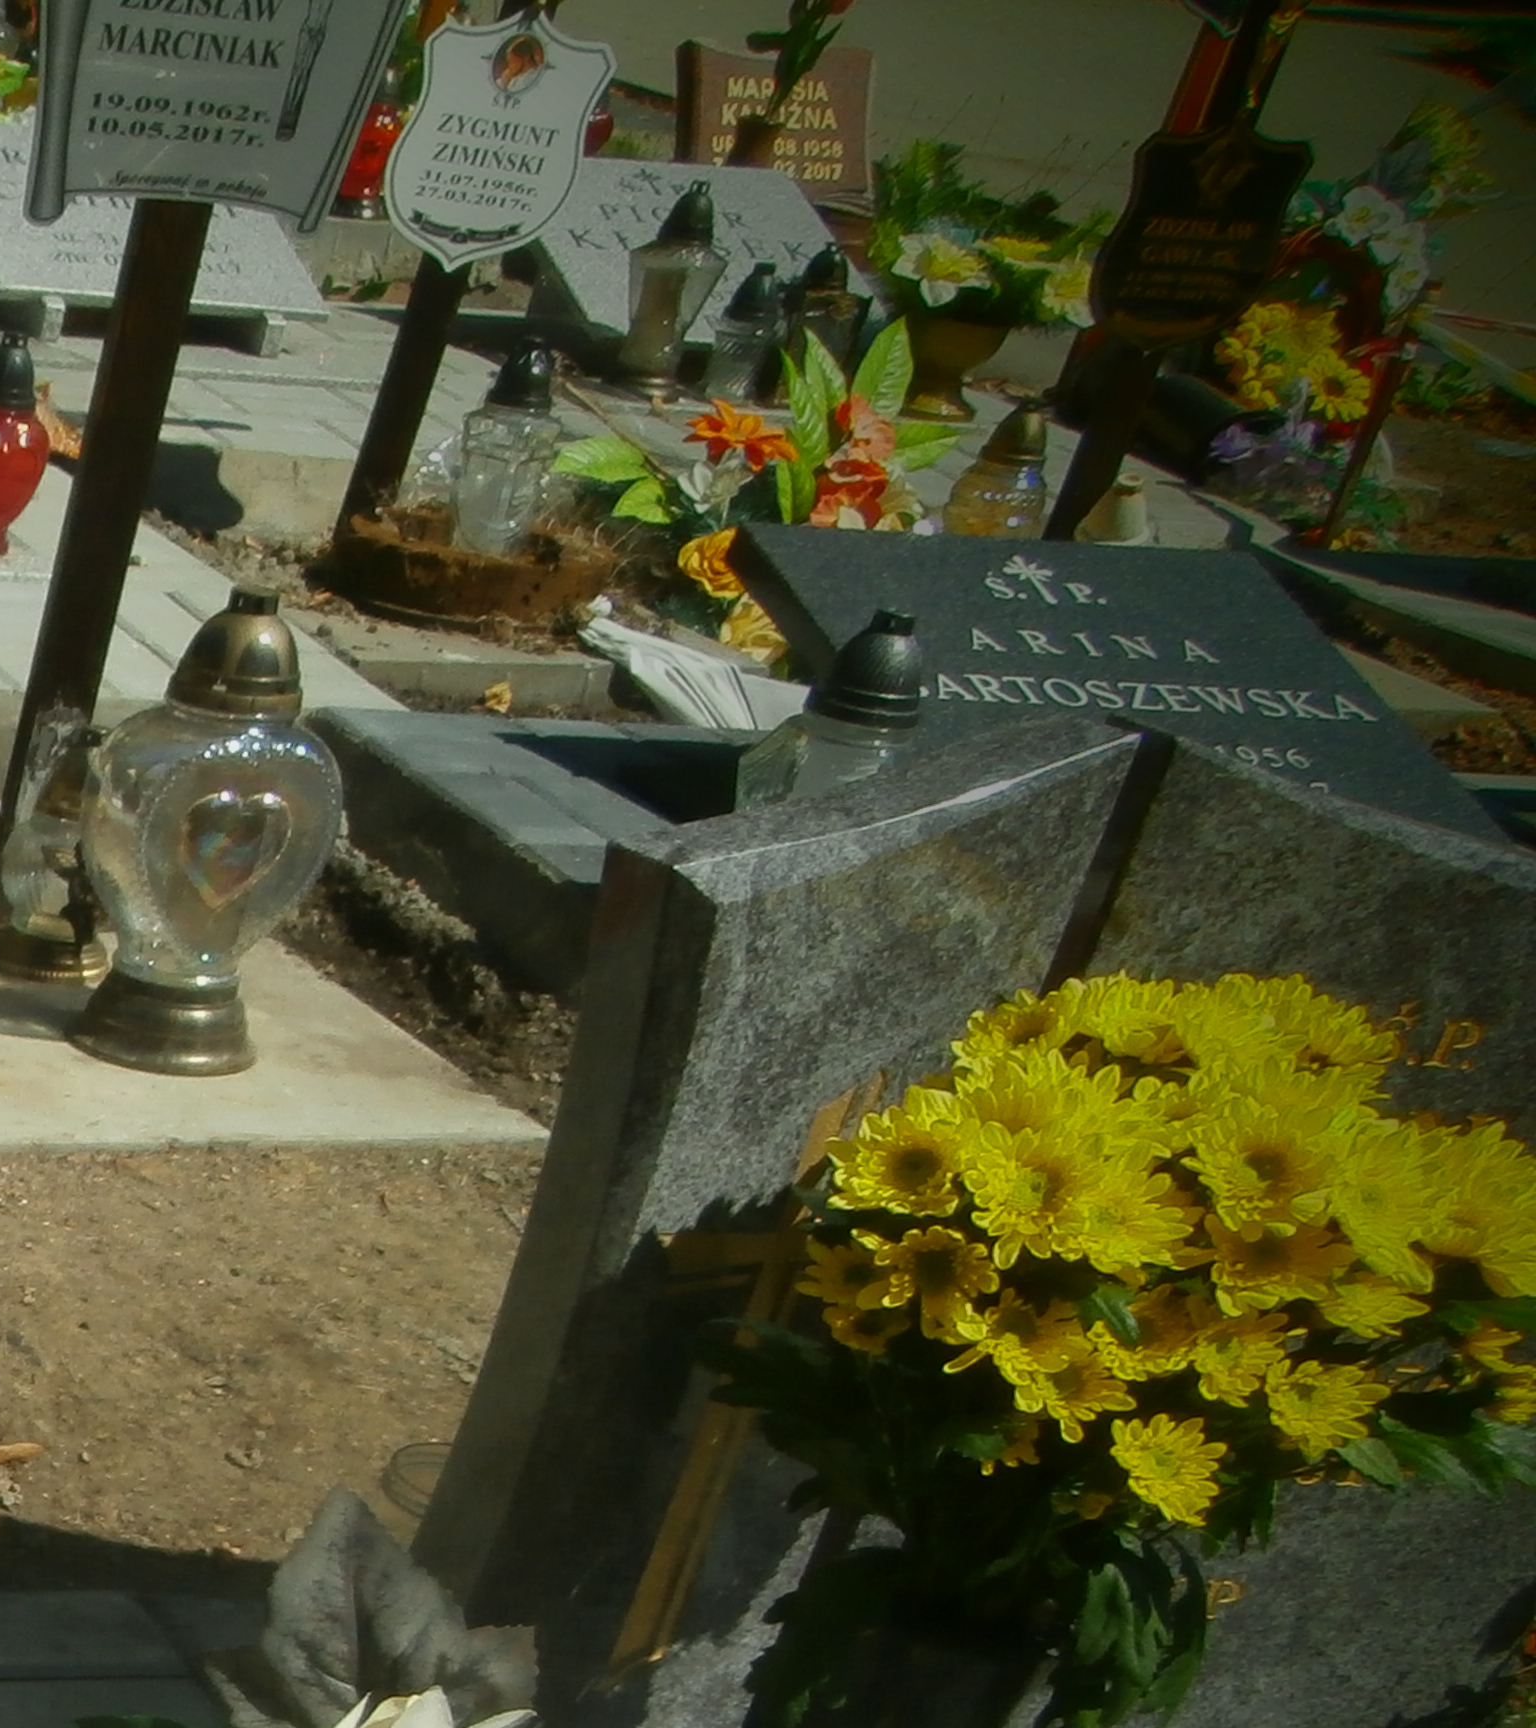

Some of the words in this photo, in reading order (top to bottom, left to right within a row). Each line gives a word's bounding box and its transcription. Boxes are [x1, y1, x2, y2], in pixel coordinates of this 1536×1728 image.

[98, 21, 286, 69] MARCINIAK
[727, 76, 830, 102] MARSIA
[93, 91, 271, 124] 19.09.1962r.
[87, 116, 265, 148] 10.05.2017r.
[436, 112, 561, 148] ZYGMUNT
[432, 142, 545, 175] ZIMIŃSKI
[970, 626, 1221, 665] ARINA
[920, 673, 1380, 723] ARTOSZEWSKA
